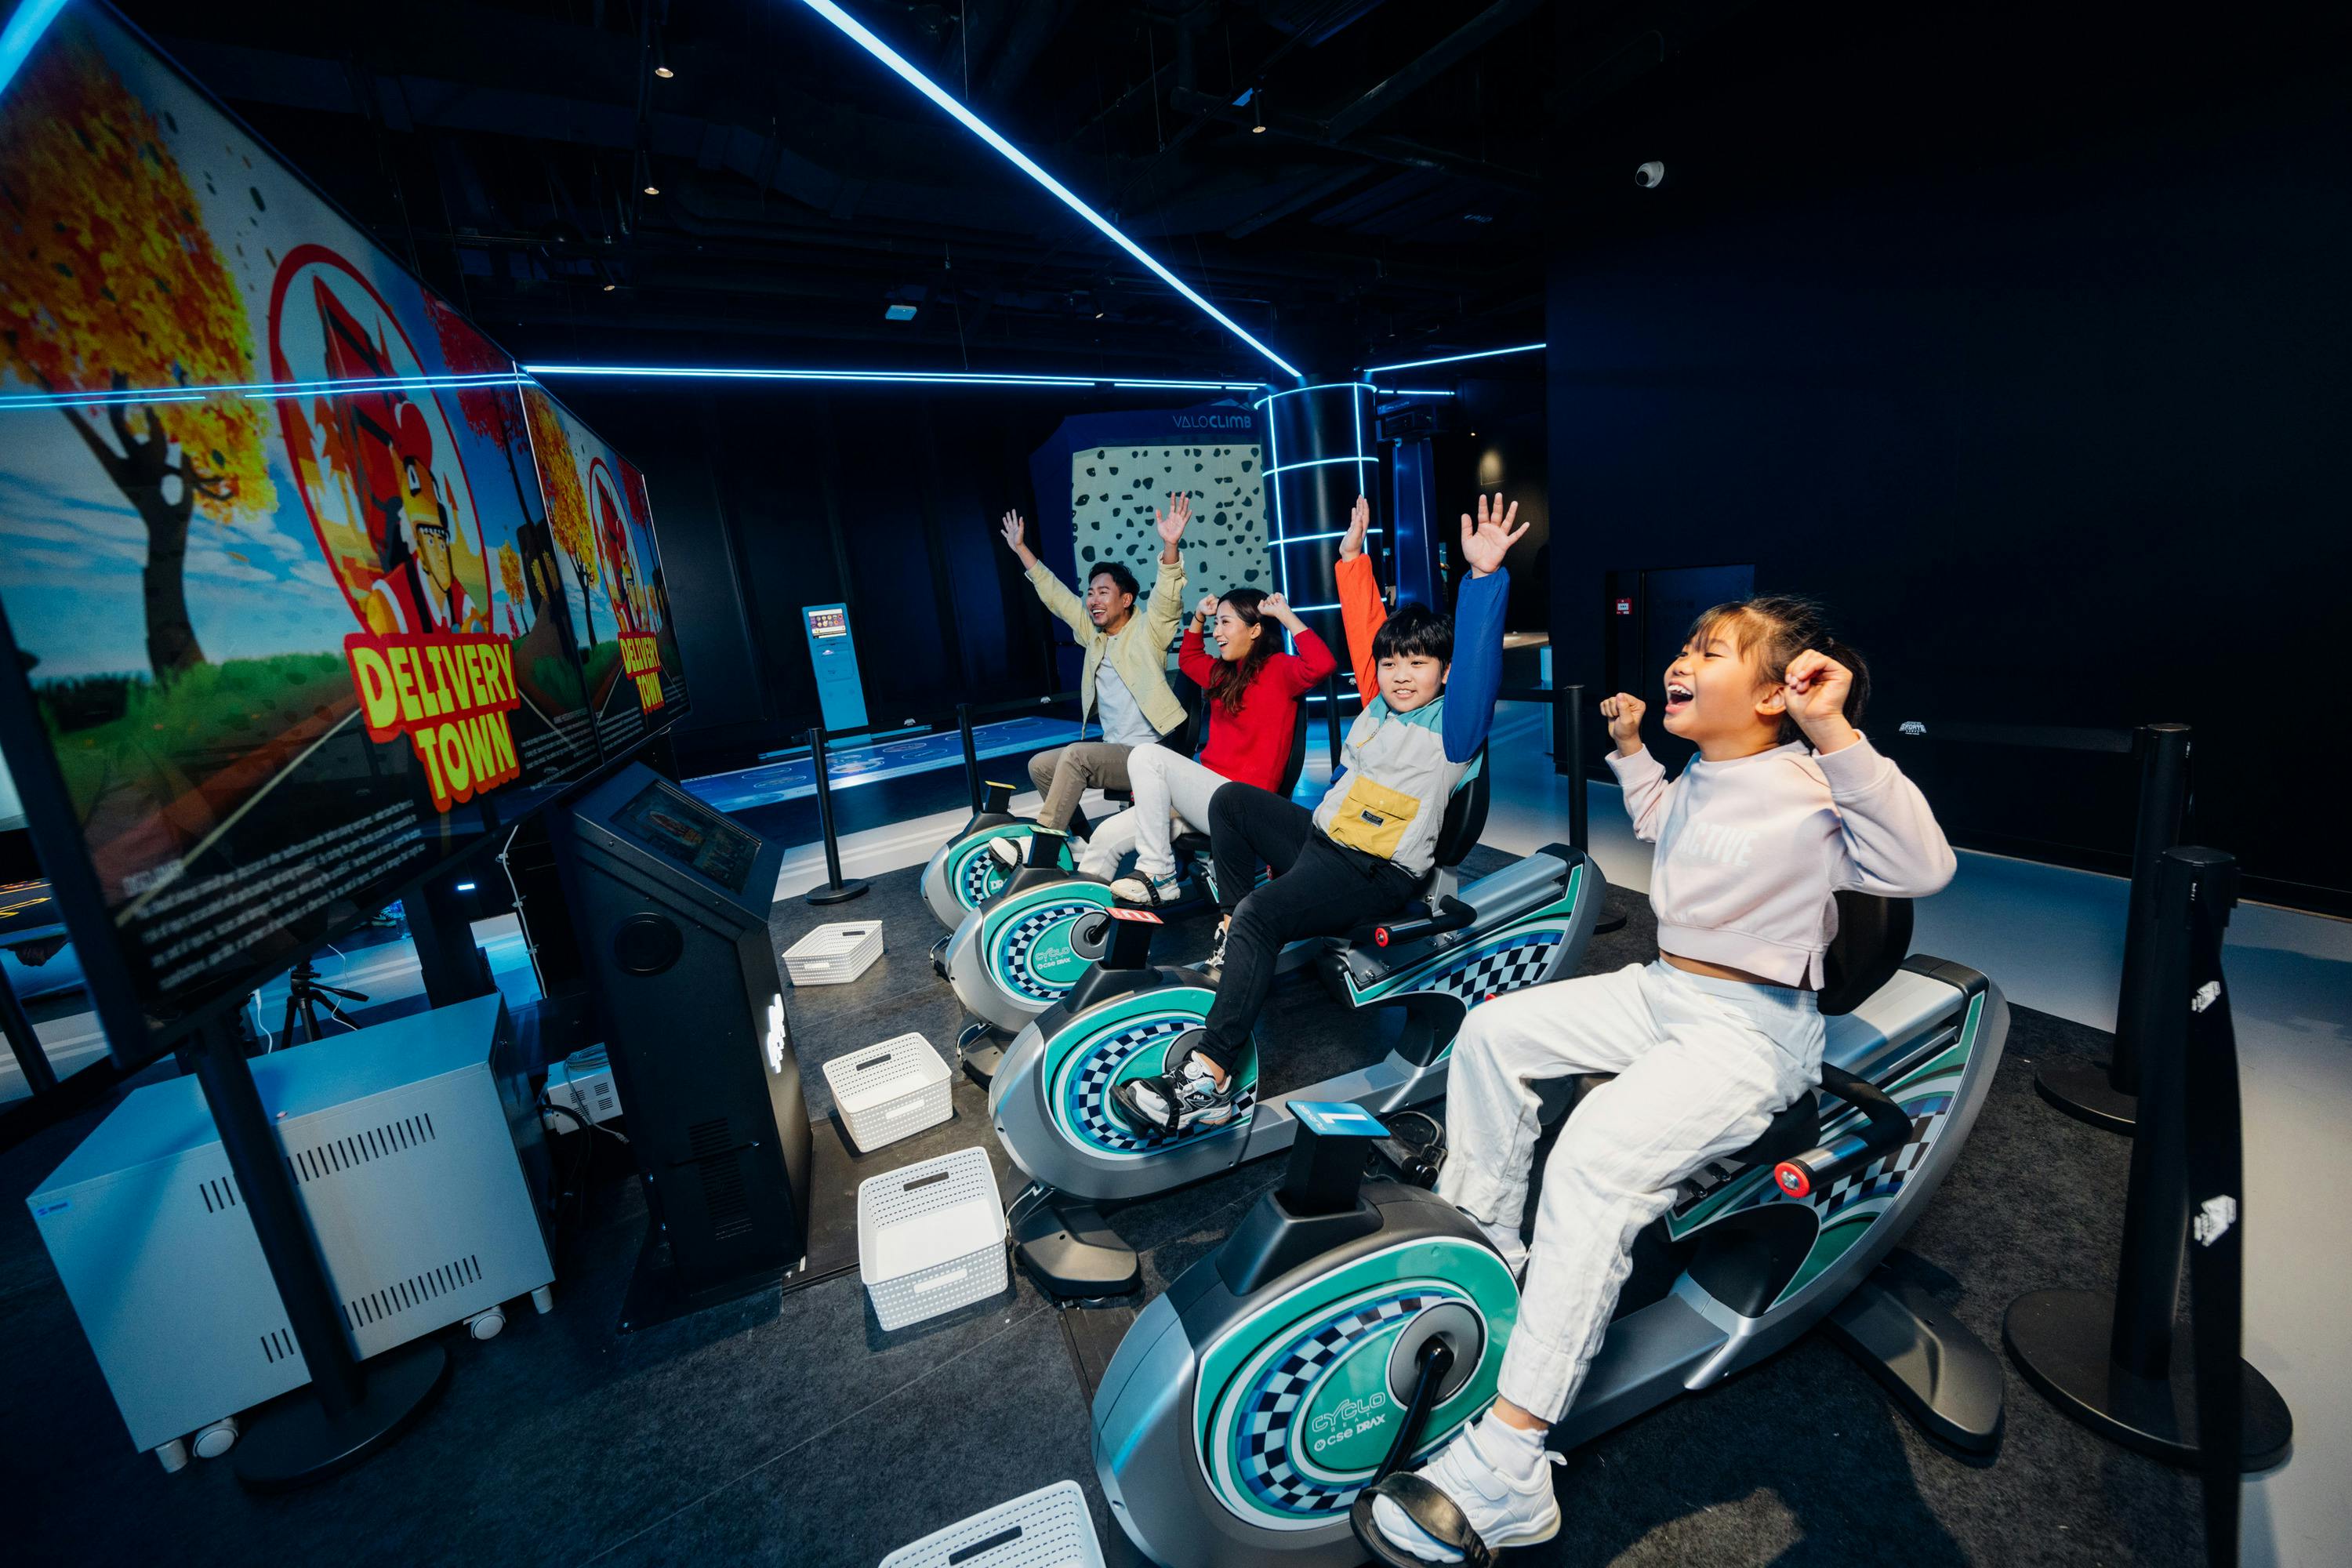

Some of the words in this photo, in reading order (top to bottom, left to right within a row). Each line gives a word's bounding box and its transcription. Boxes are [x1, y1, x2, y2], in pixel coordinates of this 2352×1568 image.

[1172, 415, 1252, 428] VALOCLIMB
[619, 637, 661, 674] DELIVERY
[351, 643, 517, 728] DELIVERY
[635, 671, 664, 710] TOWN
[415, 710, 517, 800] TOWN
[1679, 821, 1759, 867] ACTIVE
[1120, 909, 1157, 922] 2
[1036, 946, 1070, 961] CYCLO
[1317, 1112, 1368, 1124] 1
[1312, 1392, 1386, 1432] CYCLO
[1356, 1413, 1386, 1435] DRAX
